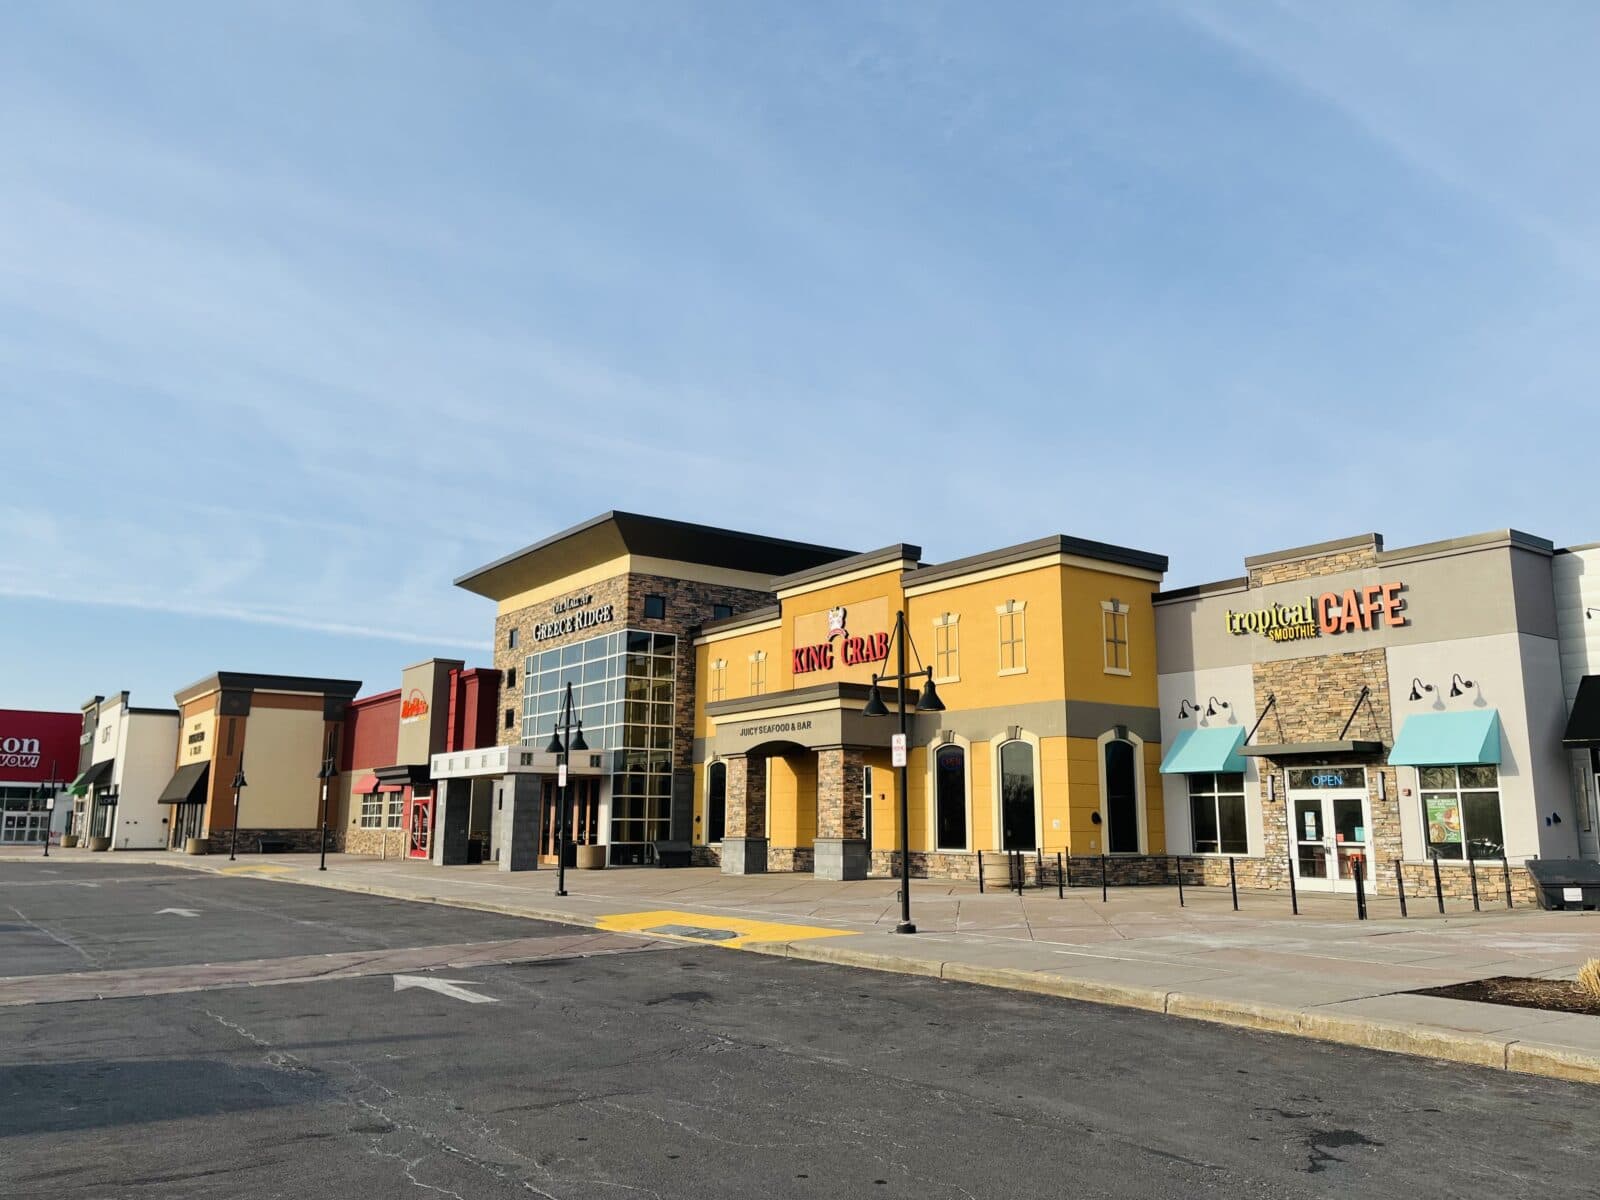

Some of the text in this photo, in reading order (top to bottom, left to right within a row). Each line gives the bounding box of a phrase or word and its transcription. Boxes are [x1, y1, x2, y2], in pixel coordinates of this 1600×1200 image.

[1225, 582, 1406, 635] tropical CAFE
[533, 604, 613, 642] GREECE RIDGE
[1268, 624, 1316, 641] SMOOTHIE
[792, 632, 888, 674] KING CRAB
[740, 720, 812, 736] JUICY SEAFOOD & BAR
[0, 737, 40, 754] on
[1312, 775, 1344, 786] OPEN
